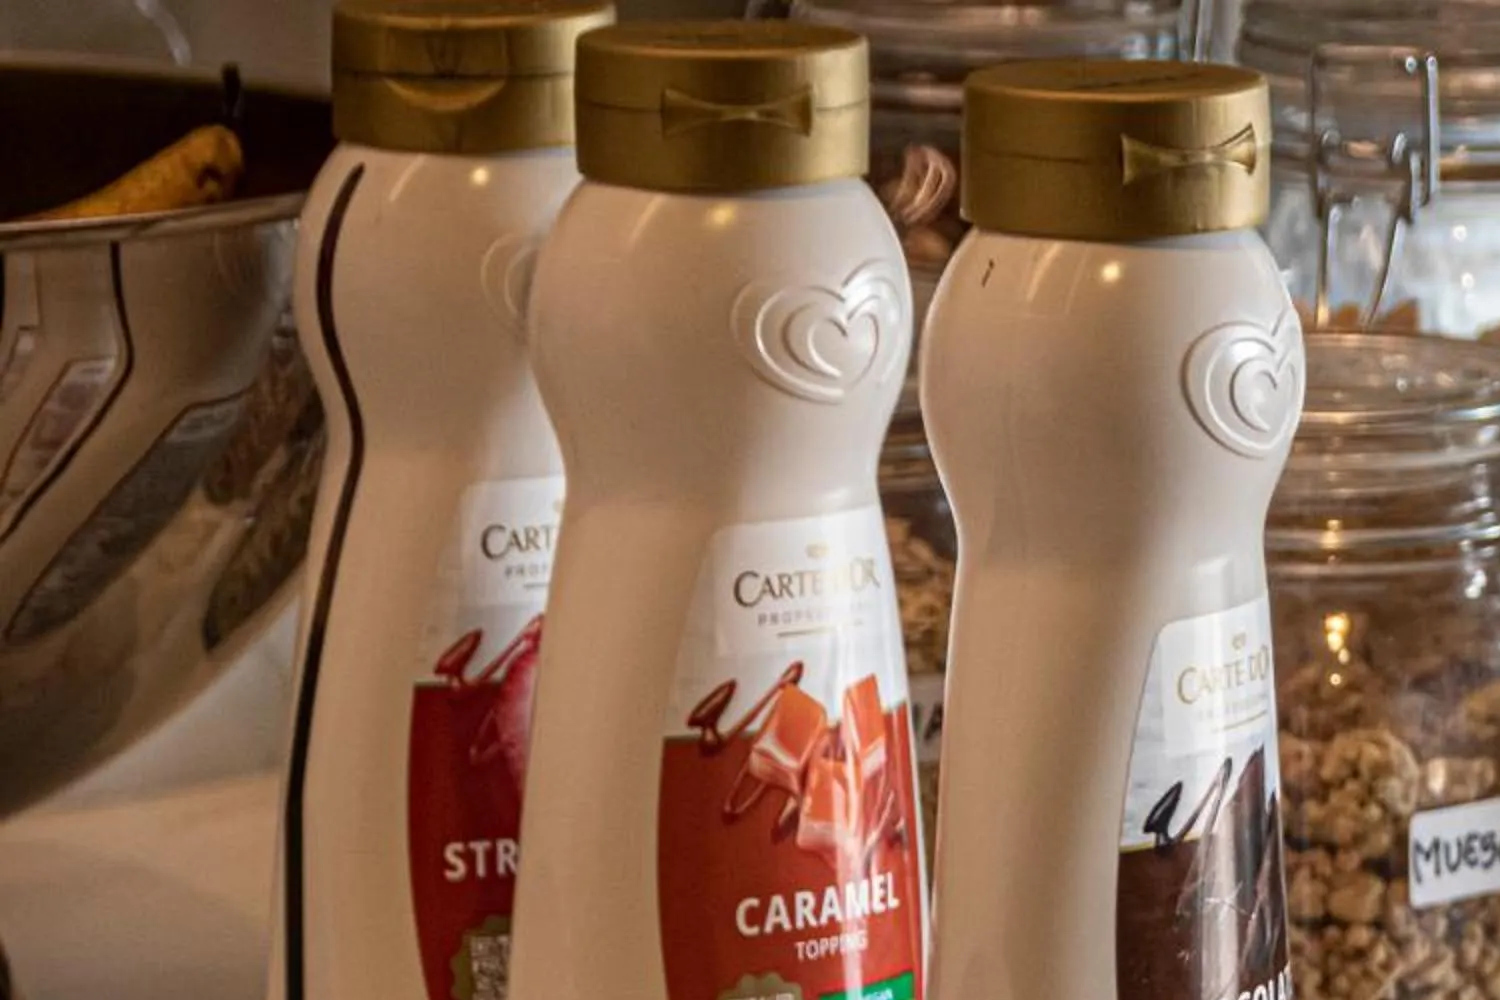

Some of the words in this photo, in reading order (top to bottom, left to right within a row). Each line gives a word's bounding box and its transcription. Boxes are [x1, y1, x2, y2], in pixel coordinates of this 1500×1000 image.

[480, 523, 556, 561] CART
[443, 838, 519, 882] STR
[735, 871, 900, 937] CARAMEL
